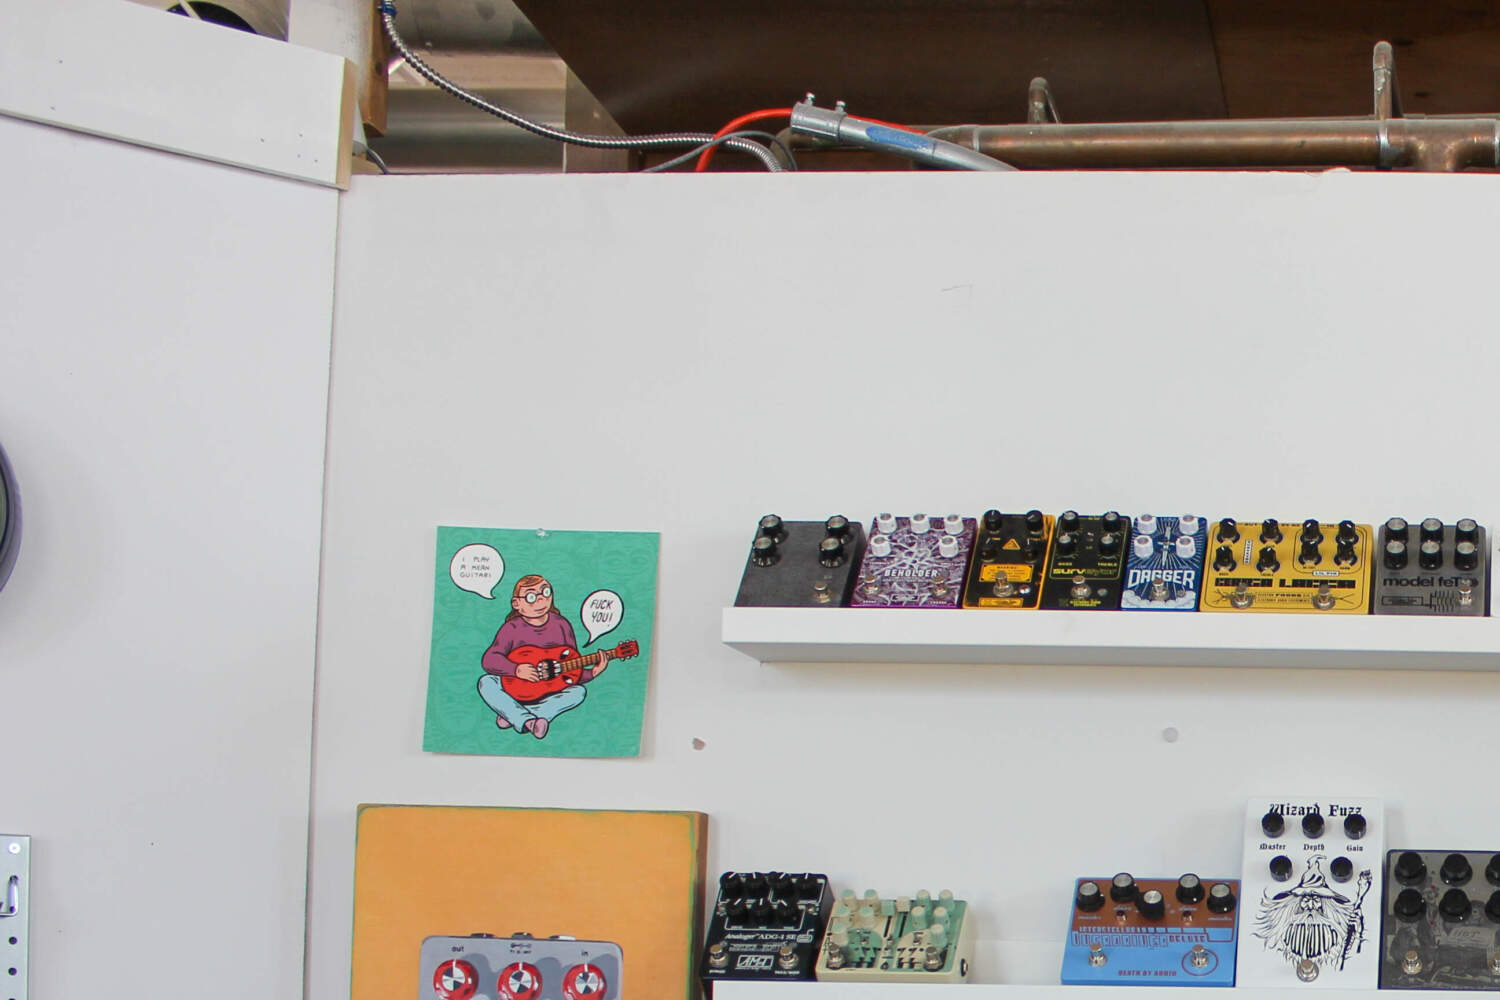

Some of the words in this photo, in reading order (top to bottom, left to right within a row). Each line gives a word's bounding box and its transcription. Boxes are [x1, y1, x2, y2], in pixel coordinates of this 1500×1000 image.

[884, 569, 939, 577] BEHOLDER
[1127, 569, 1196, 589] DAGGER
[1383, 576, 1434, 587] model
[590, 599, 613, 610] FUCK
[1269, 802, 1321, 816] Wizard
[1328, 804, 1363, 817] Fuzz
[1303, 843, 1325, 852] Depth
